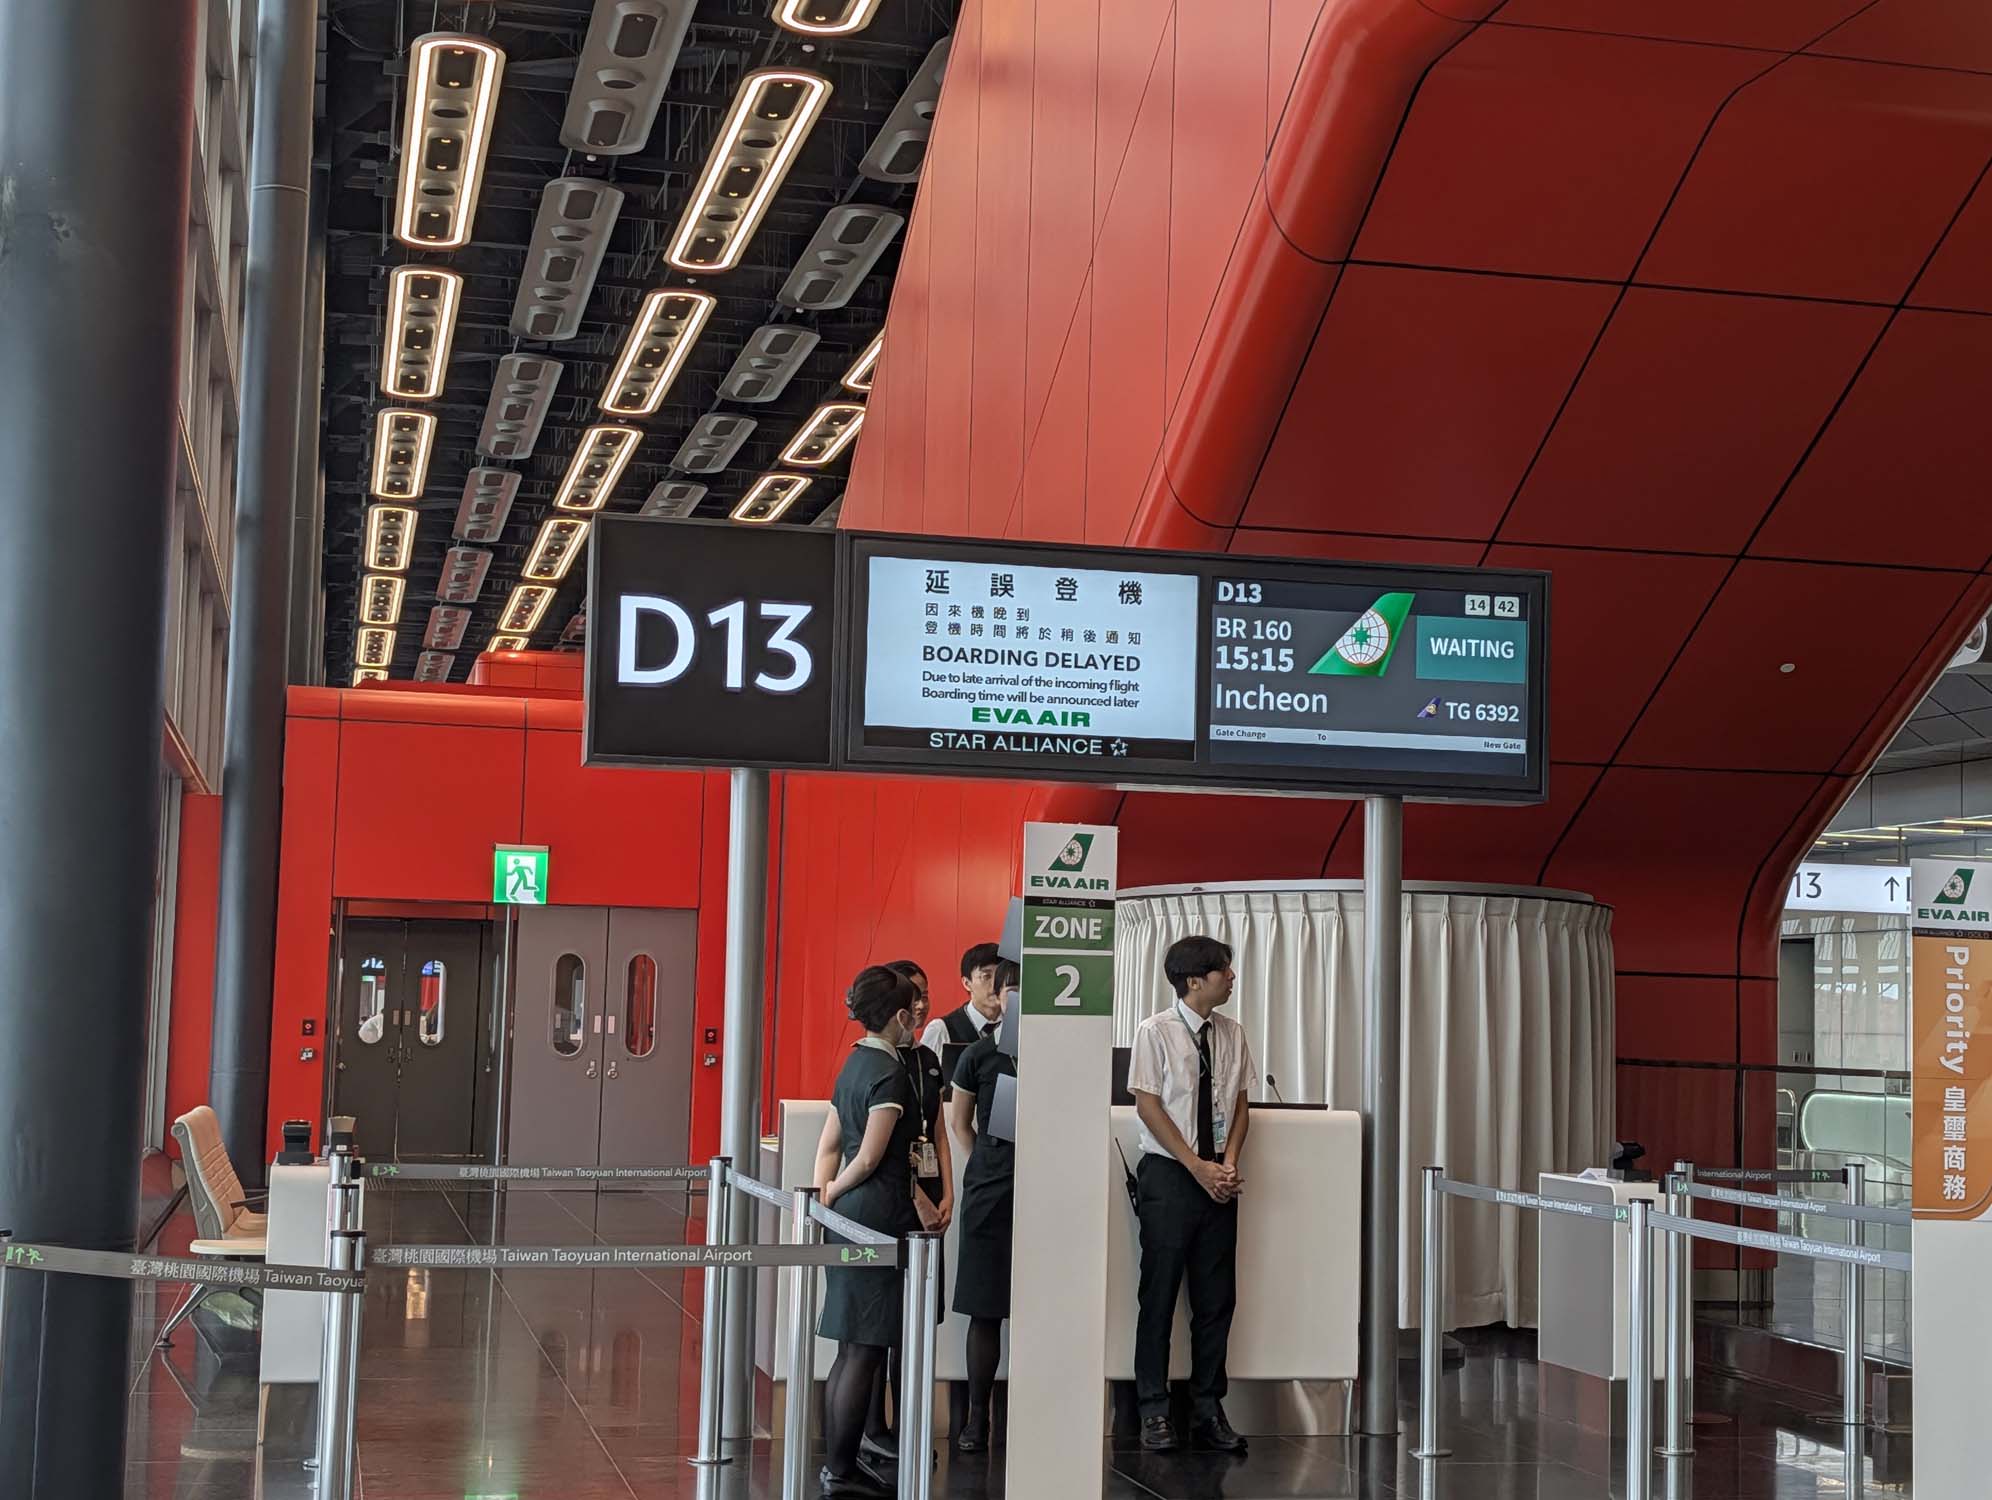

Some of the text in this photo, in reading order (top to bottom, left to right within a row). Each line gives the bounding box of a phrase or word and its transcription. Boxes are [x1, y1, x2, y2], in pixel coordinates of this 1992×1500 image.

[925, 569, 1142, 605] 延誤登機
[1217, 581, 1263, 604] D13
[925, 602, 1030, 622] 因來機晚到
[1469, 599, 1515, 613] 14 42
[925, 620, 1142, 645] 登機時間將於稍後通知
[1215, 617, 1292, 641] BR 160
[616, 594, 813, 691] D13
[1430, 636, 1515, 659] WAITING
[922, 645, 1141, 671] BOARDING DELAYED
[1215, 645, 1294, 672] 15:15
[922, 671, 1140, 694] Due to late arrival of the incoming flight
[922, 687, 1140, 708] Boarding time will be announced later
[1216, 683, 1328, 714] Incheon
[1445, 702, 1520, 722] TG 6392
[929, 732, 1103, 755] STAR ALLIANCE
[1215, 729, 1267, 740] Gate Change
[1483, 741, 1521, 750] New Gate
[1034, 915, 1102, 941] ZONE
[1053, 964, 1081, 1007] 2
[1939, 945, 1971, 1074] Priority
[1943, 1085, 1968, 1200] 皇璽商務
[541, 1167, 574, 1178] Taiwan
[574, 1167, 614, 1179] Taoyuan
[615, 1168, 673, 1178] International
[673, 1168, 707, 1180] Airport
[1697, 1168, 1772, 1180] International Airport
[500, 1248, 548, 1262] Taiwan
[551, 1248, 610, 1265] Taoyuan
[614, 1248, 700, 1263] International
[703, 1248, 753, 1264] Airport
[1800, 1239, 1823, 1255] Taoyuan
[1823, 1243, 1859, 1259] International
[1859, 1250, 1881, 1264] Airport
[130, 1258, 260, 1285] 臺灣桃園國際機場
[264, 1268, 313, 1286] Taiwan
